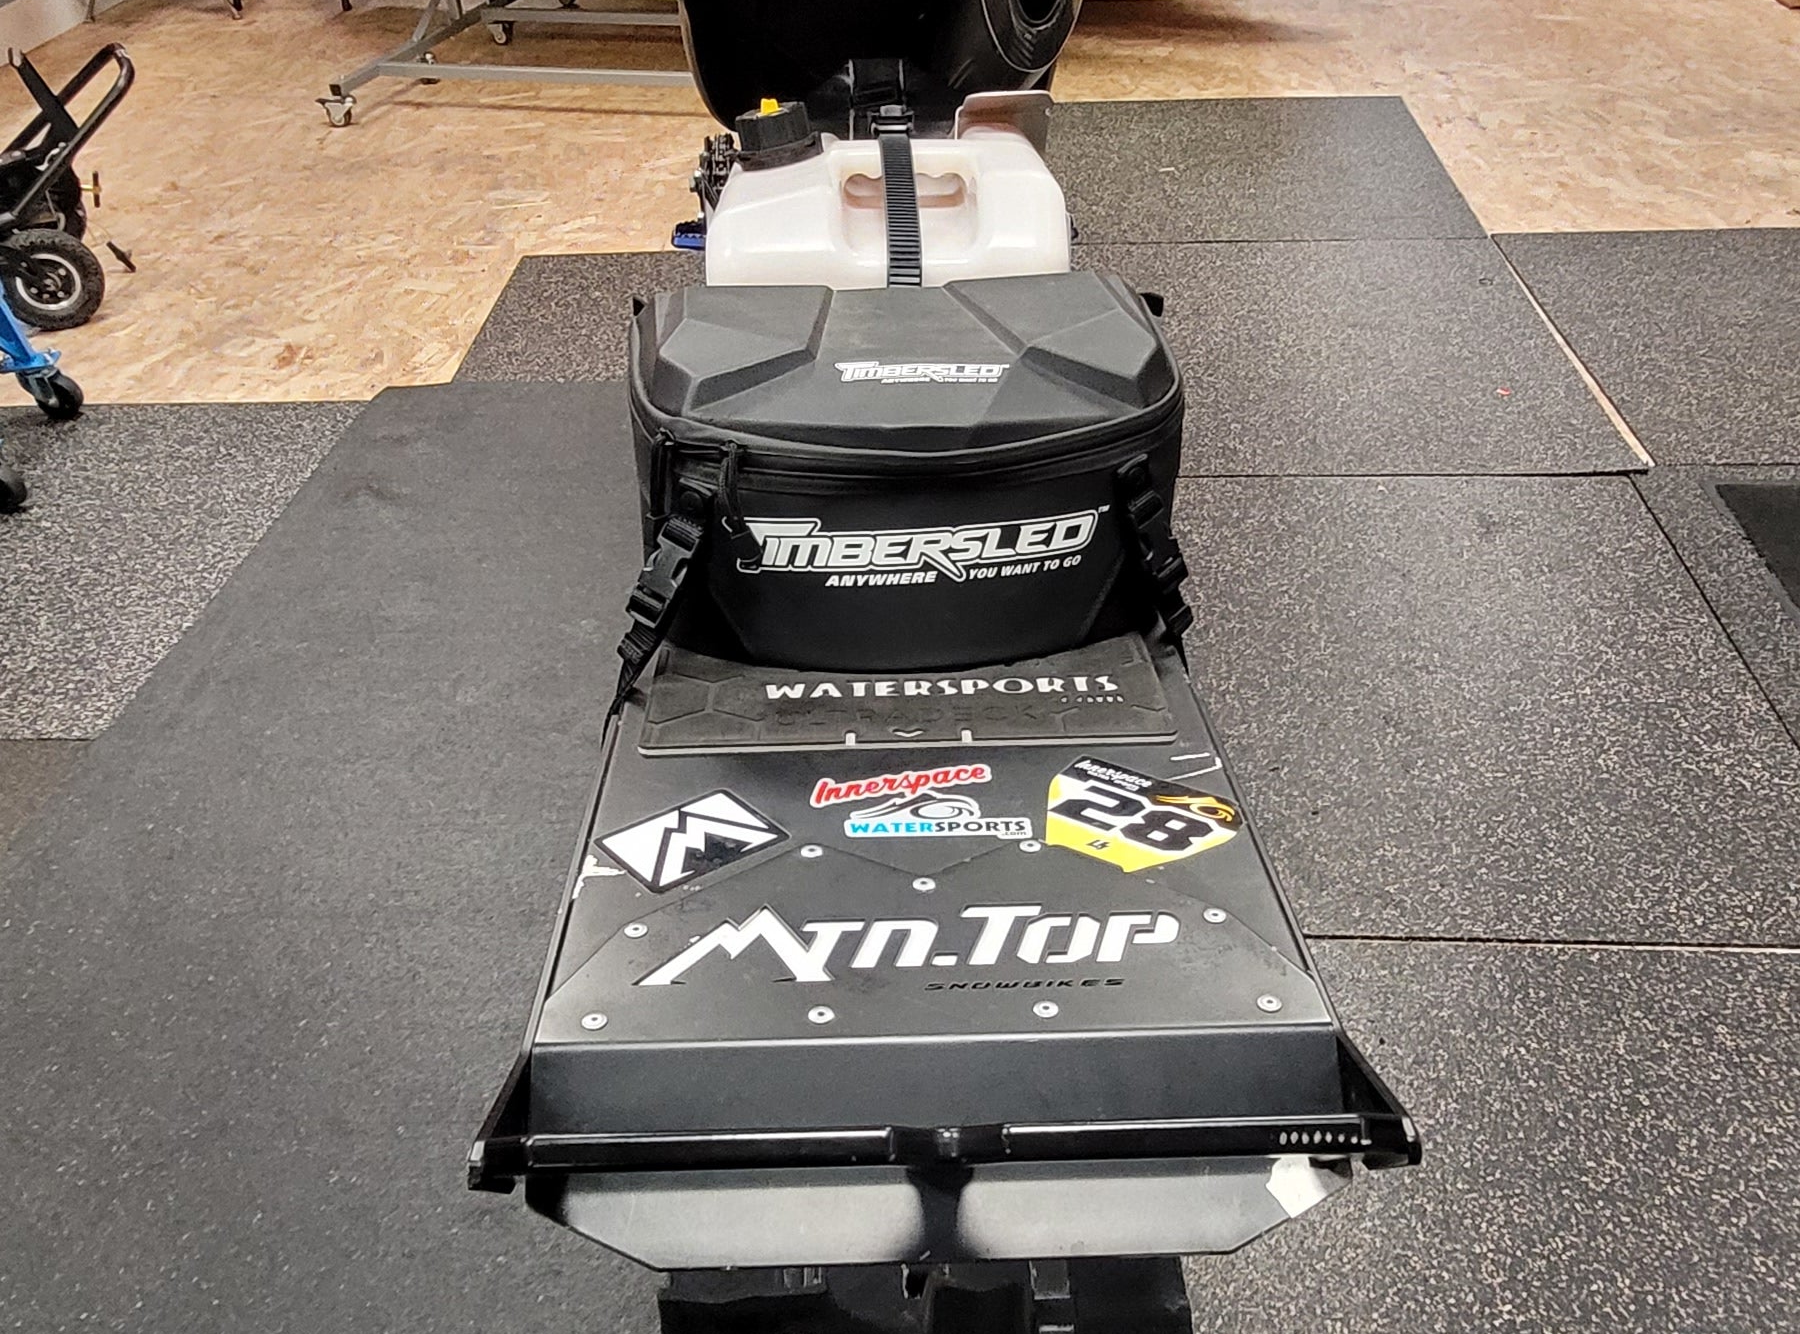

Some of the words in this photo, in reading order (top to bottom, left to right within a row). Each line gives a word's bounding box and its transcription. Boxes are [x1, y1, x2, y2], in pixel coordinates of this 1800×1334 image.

[825, 570, 938, 587] ANYWHERE
[968, 566, 996, 580] YOU
[1000, 561, 1041, 578] WANT
[1042, 559, 1061, 572] TO
[1062, 554, 1082, 568] GO
[765, 675, 1120, 699] WATERSPORTS
[813, 765, 987, 805] Innerspace
[850, 820, 1027, 834] WATERSPORTS
[1049, 785, 1214, 851] 28
[923, 977, 1126, 992] SNOWBIKES
